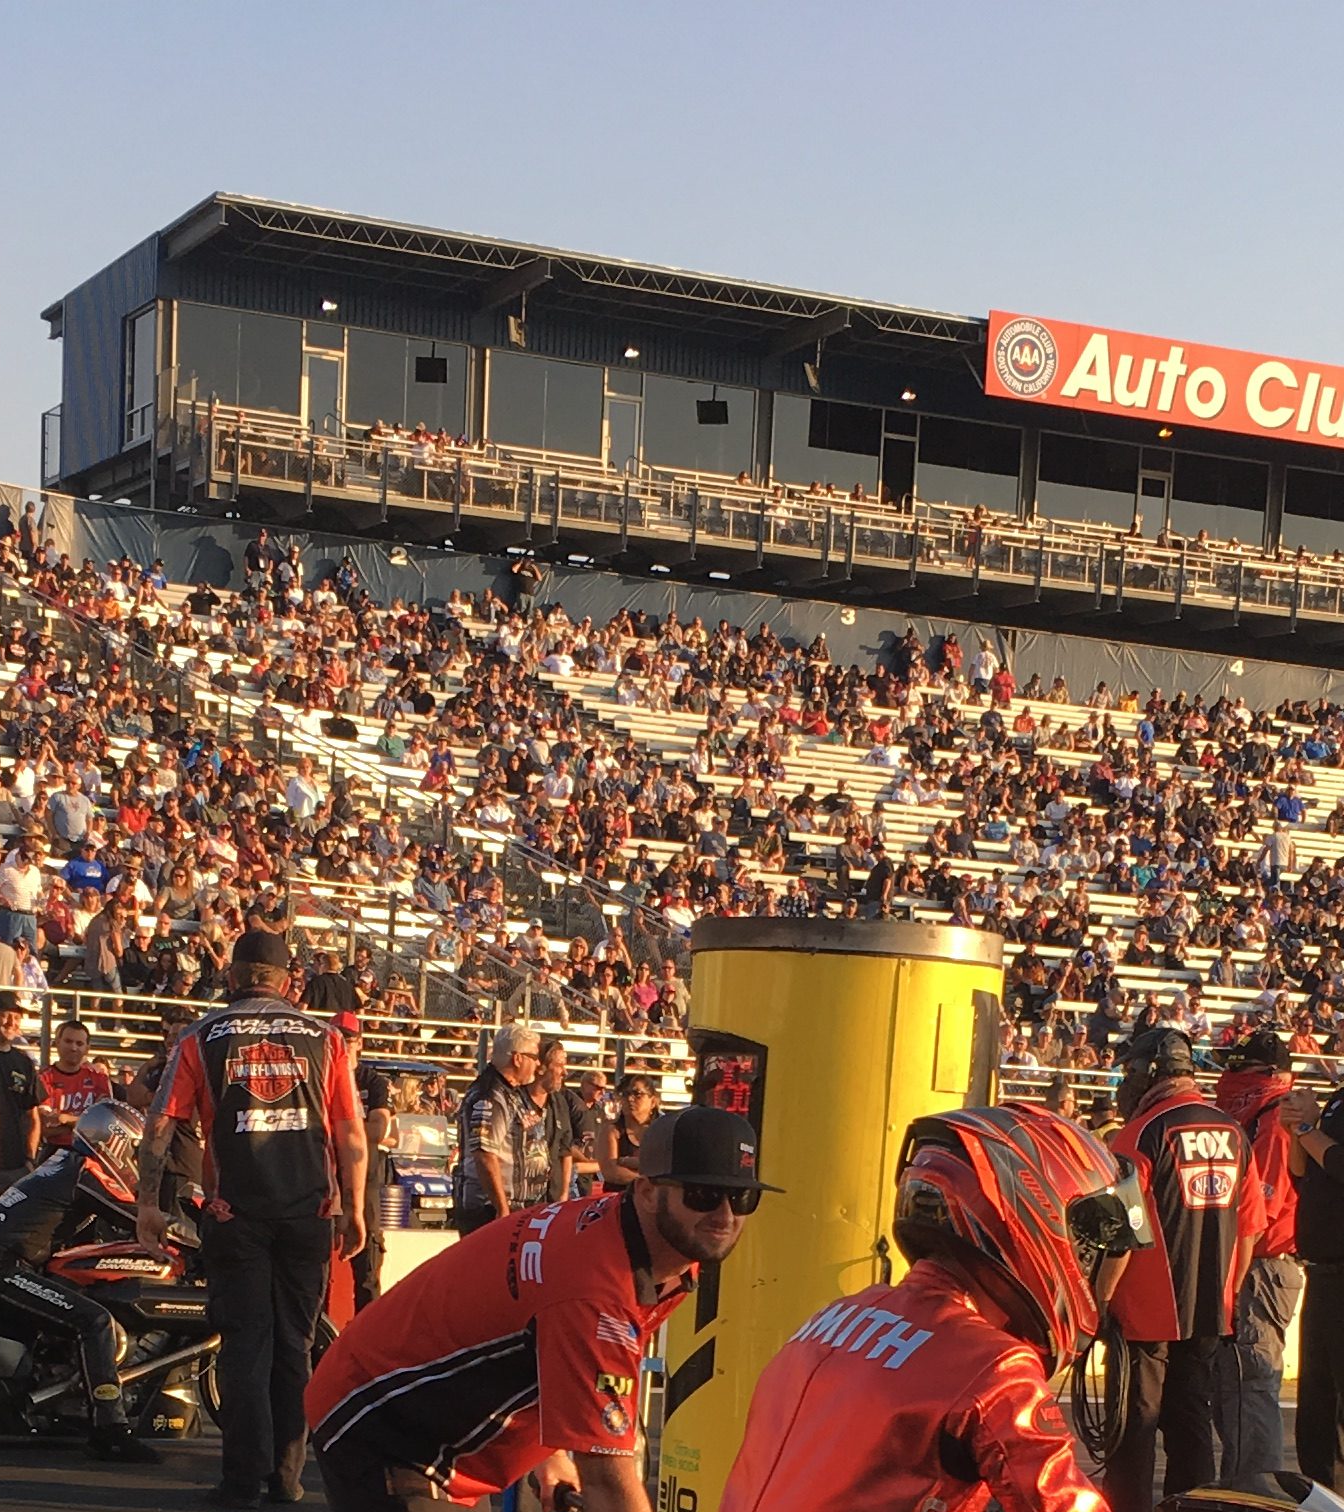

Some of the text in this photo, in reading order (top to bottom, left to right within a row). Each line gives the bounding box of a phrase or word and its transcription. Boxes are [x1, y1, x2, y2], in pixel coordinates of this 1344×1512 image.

[1000, 321, 1055, 356] AUTOMOBILE CLUB
[1012, 345, 1041, 366] AAA
[998, 350, 1055, 394] SOUTHERN CALIFORNIA
[1059, 332, 1227, 419] Auto
[389, 546, 408, 565] 2
[840, 608, 856, 625] 3
[1229, 659, 1244, 676] 4
[206, 1024, 321, 1043] DAVIDSON
[1180, 1130, 1235, 1162] FOX
[1194, 1174, 1230, 1195] NHRA
[95, 1263, 163, 1272] DAVIDSON
[596, 1373, 636, 1397] PJ1
